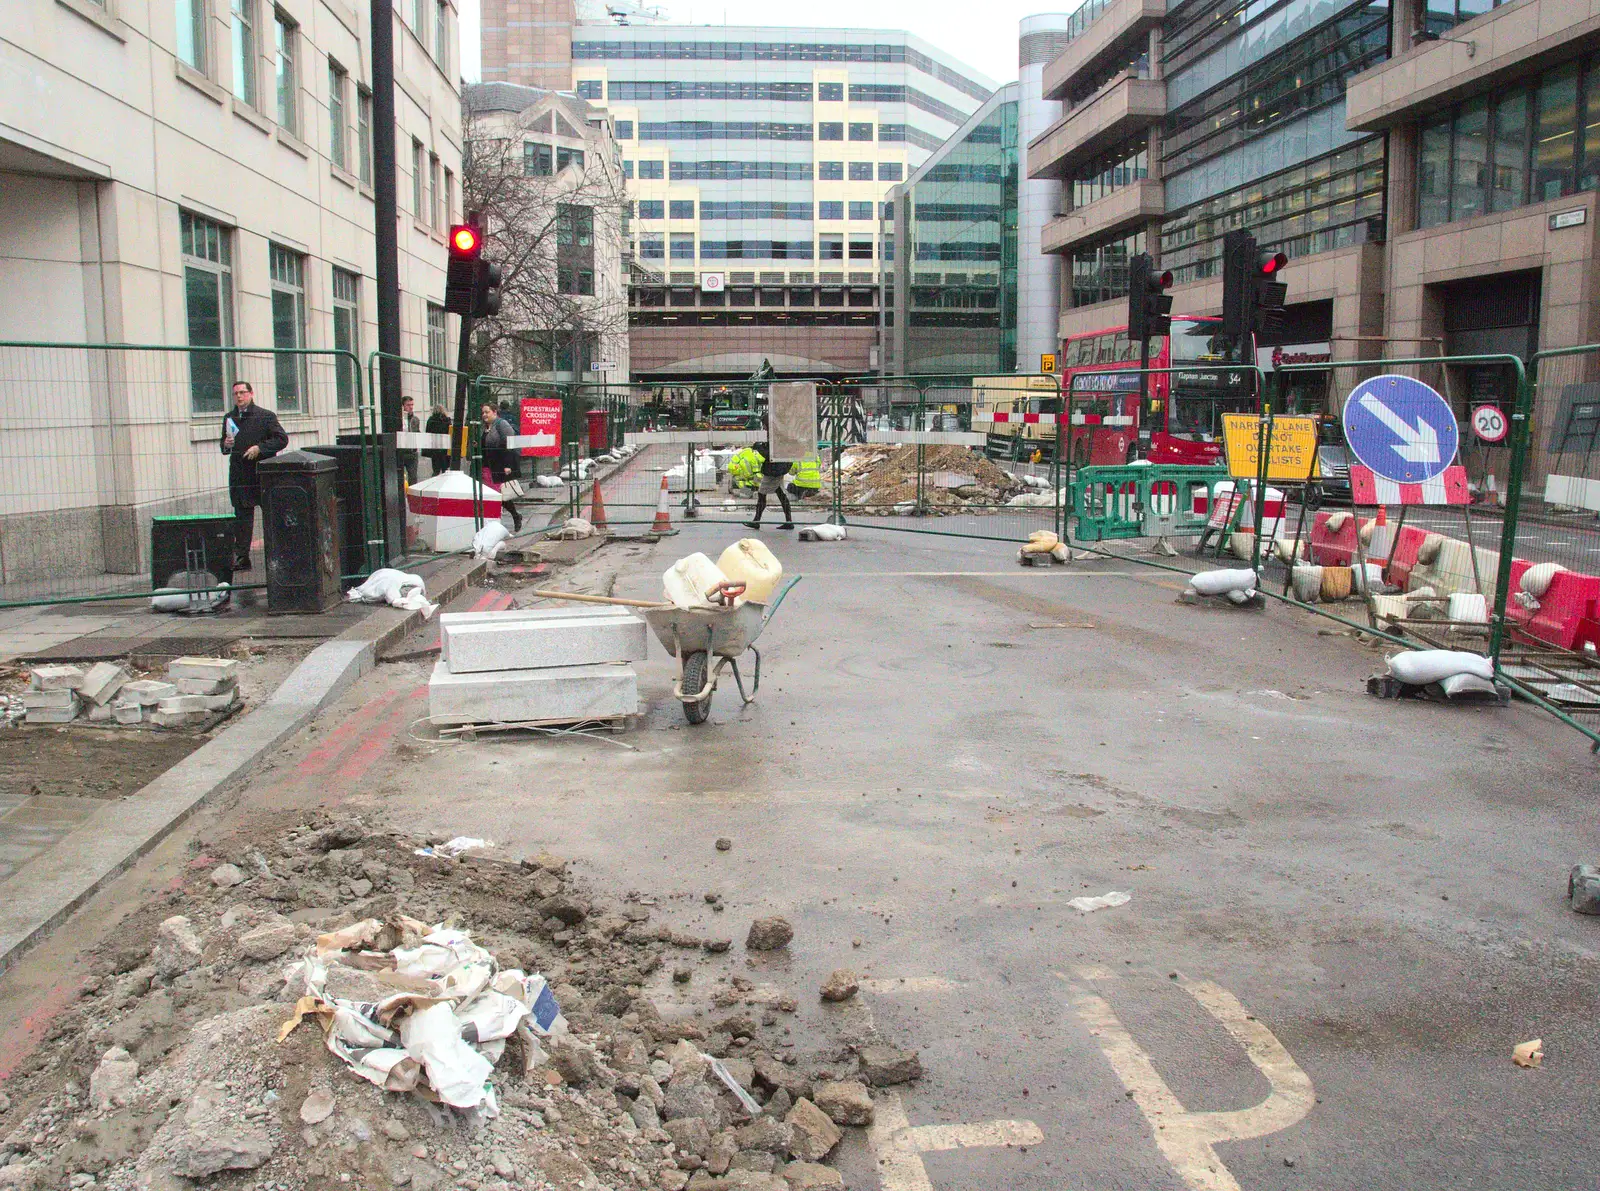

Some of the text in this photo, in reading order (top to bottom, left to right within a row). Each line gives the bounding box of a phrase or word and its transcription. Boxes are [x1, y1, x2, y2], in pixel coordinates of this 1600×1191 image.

[1283, 423, 1311, 432] LANE
[1478, 415, 1502, 431] 20
[1271, 433, 1293, 442] NOT
